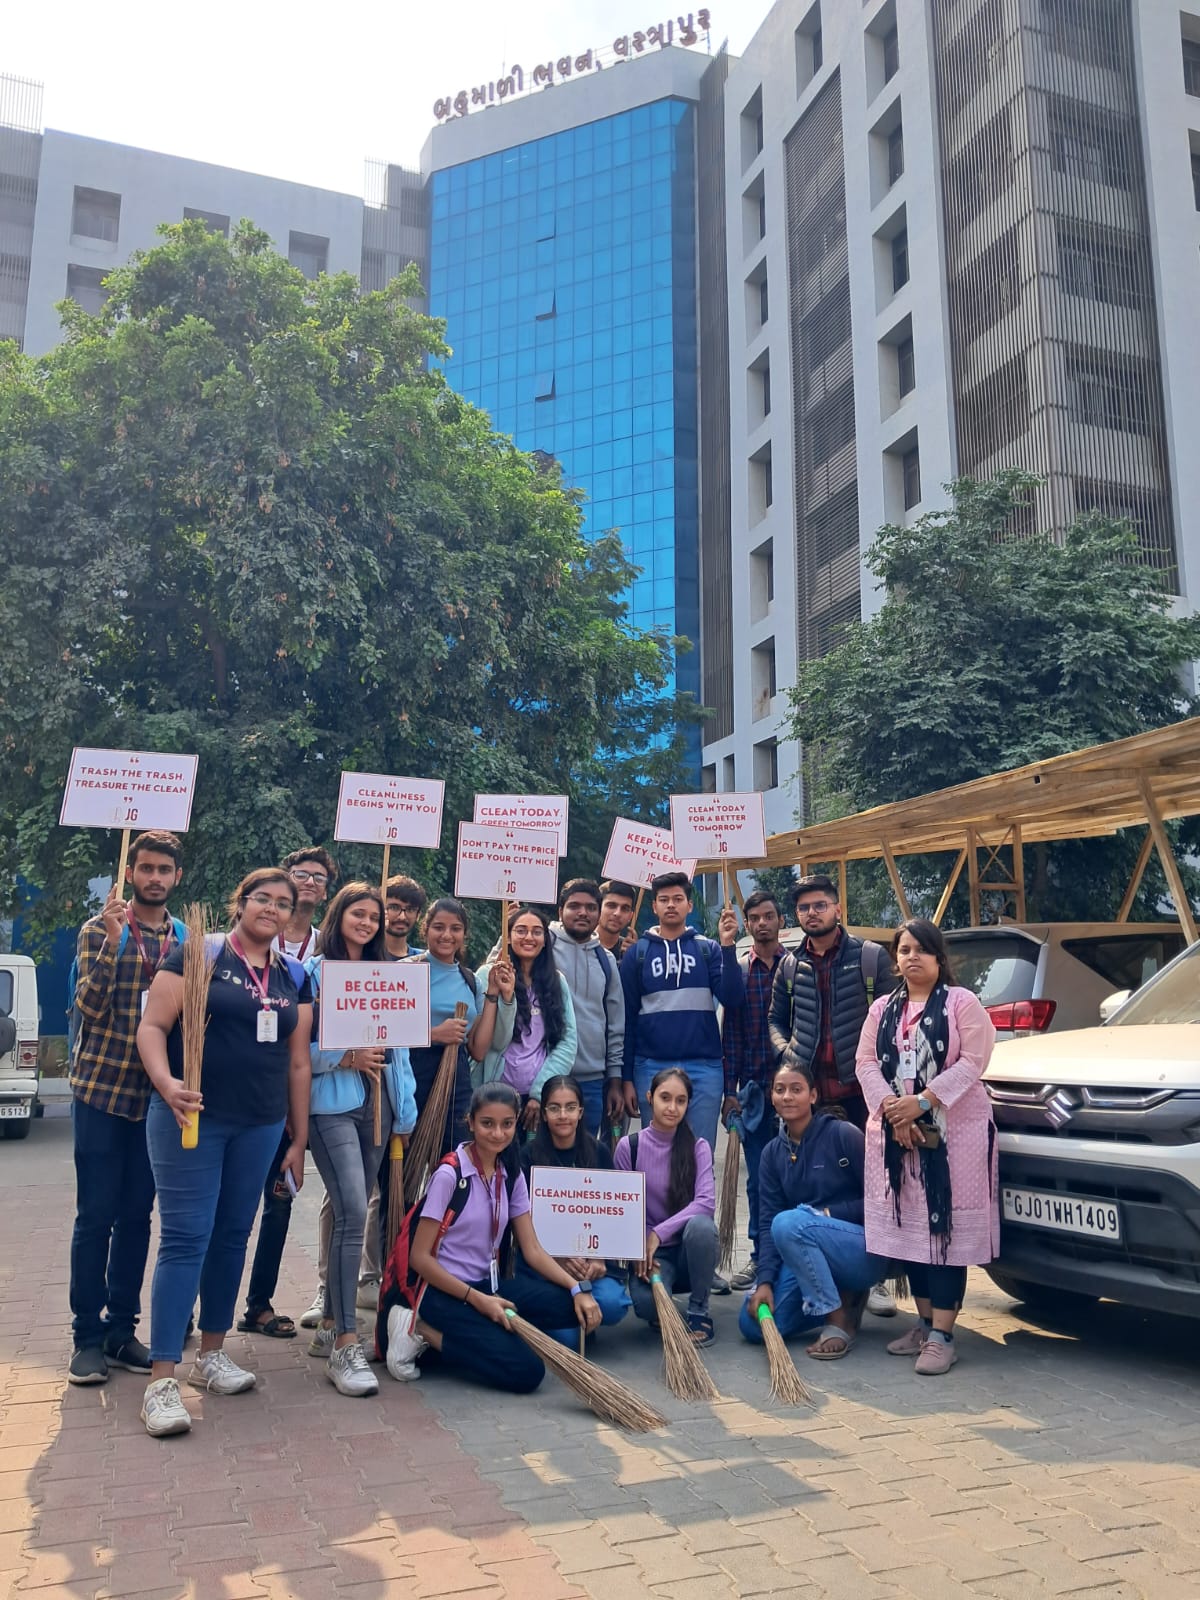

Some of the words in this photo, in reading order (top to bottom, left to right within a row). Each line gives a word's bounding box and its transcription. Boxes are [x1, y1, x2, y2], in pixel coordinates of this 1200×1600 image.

[80, 766, 118, 776] TRASH
[121, 770, 142, 778] THE
[74, 780, 128, 790] TREASURE
[131, 784, 150, 792] THE
[154, 784, 187, 793] CLEAN
[358, 789, 426, 801] CLEANLINESS
[347, 799, 384, 808] BEGINS
[387, 804, 412, 812] WITH
[416, 806, 437, 814] YOU
[481, 808, 517, 816] CLEAN
[124, 808, 138, 820] JG
[387, 827, 398, 838] JG
[627, 832, 653, 844] KEEP
[513, 844, 528, 852] THE
[624, 844, 648, 856] CITY
[718, 842, 728, 852] JG
[462, 852, 484, 860] KEEP
[487, 854, 510, 862] YOUR
[514, 856, 532, 864] CITY
[536, 858, 554, 866] NICE
[506, 881, 516, 892] JG
[652, 953, 696, 977] GAP
[345, 981, 360, 992] BE
[364, 981, 408, 992] CLEAN,
[336, 998, 366, 1010] LIVE
[370, 998, 416, 1010] GREEN
[376, 1026, 387, 1039] JG
[535, 1188, 600, 1200] CLEANLINESS
[614, 1193, 640, 1201] NEXT
[552, 1204, 565, 1213] TO
[568, 1205, 624, 1216] GODLINESS
[1014, 1195, 1117, 1232] GJ01WH1409
[588, 1235, 599, 1249] JG
